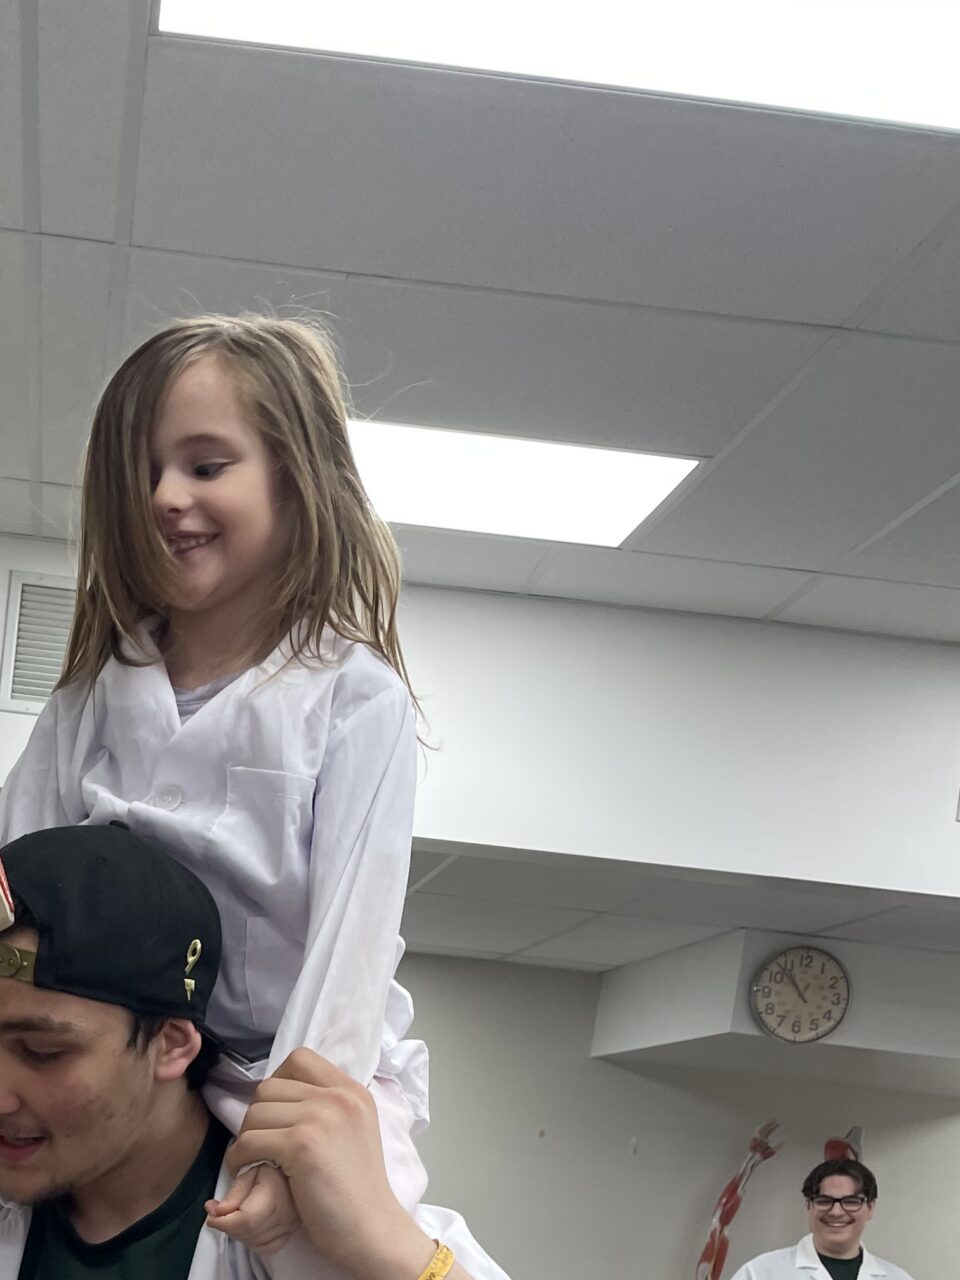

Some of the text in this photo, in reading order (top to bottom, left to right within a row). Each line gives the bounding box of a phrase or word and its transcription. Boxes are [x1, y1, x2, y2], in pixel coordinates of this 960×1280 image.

[799, 955, 814, 969] 12
[820, 962, 825, 975] 1
[768, 971, 784, 985] 10
[829, 976, 839, 990] 2
[761, 986, 772, 999] 9
[831, 993, 841, 1006] 3
[765, 1002, 775, 1016] 8
[823, 1009, 832, 1022] 4
[776, 1015, 786, 1028] 7
[792, 1020, 801, 1034] 6
[809, 1018, 819, 1031] 5
